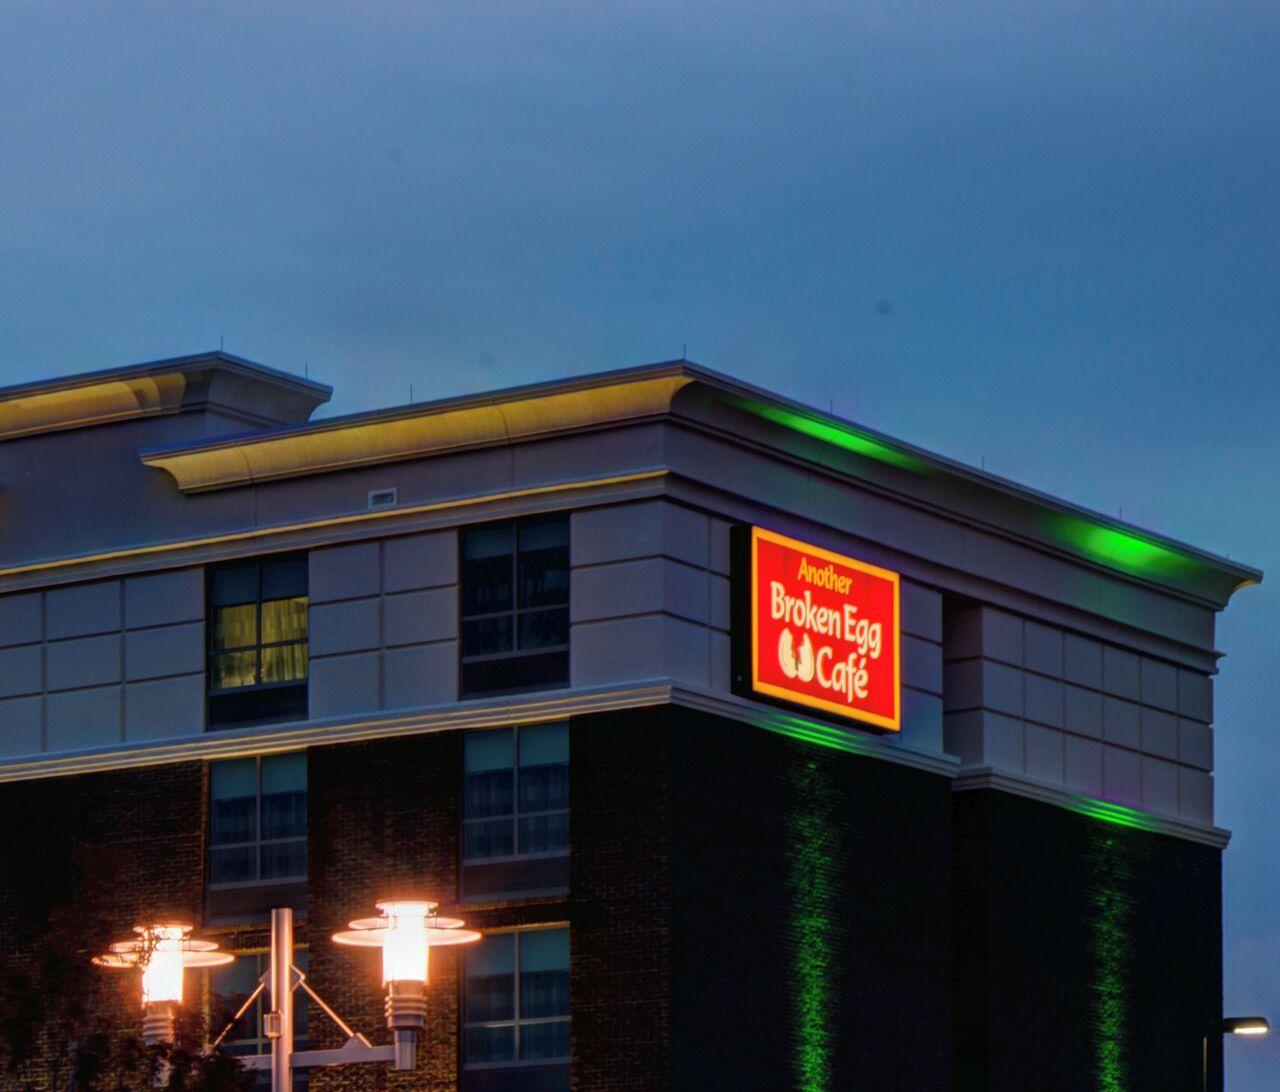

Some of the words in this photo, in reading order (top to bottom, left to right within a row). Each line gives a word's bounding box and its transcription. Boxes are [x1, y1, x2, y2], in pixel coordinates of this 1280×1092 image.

[797, 557, 853, 595] Another
[770, 580, 841, 639] Broken
[843, 604, 882, 659] Egg
[816, 646, 869, 703] Café
